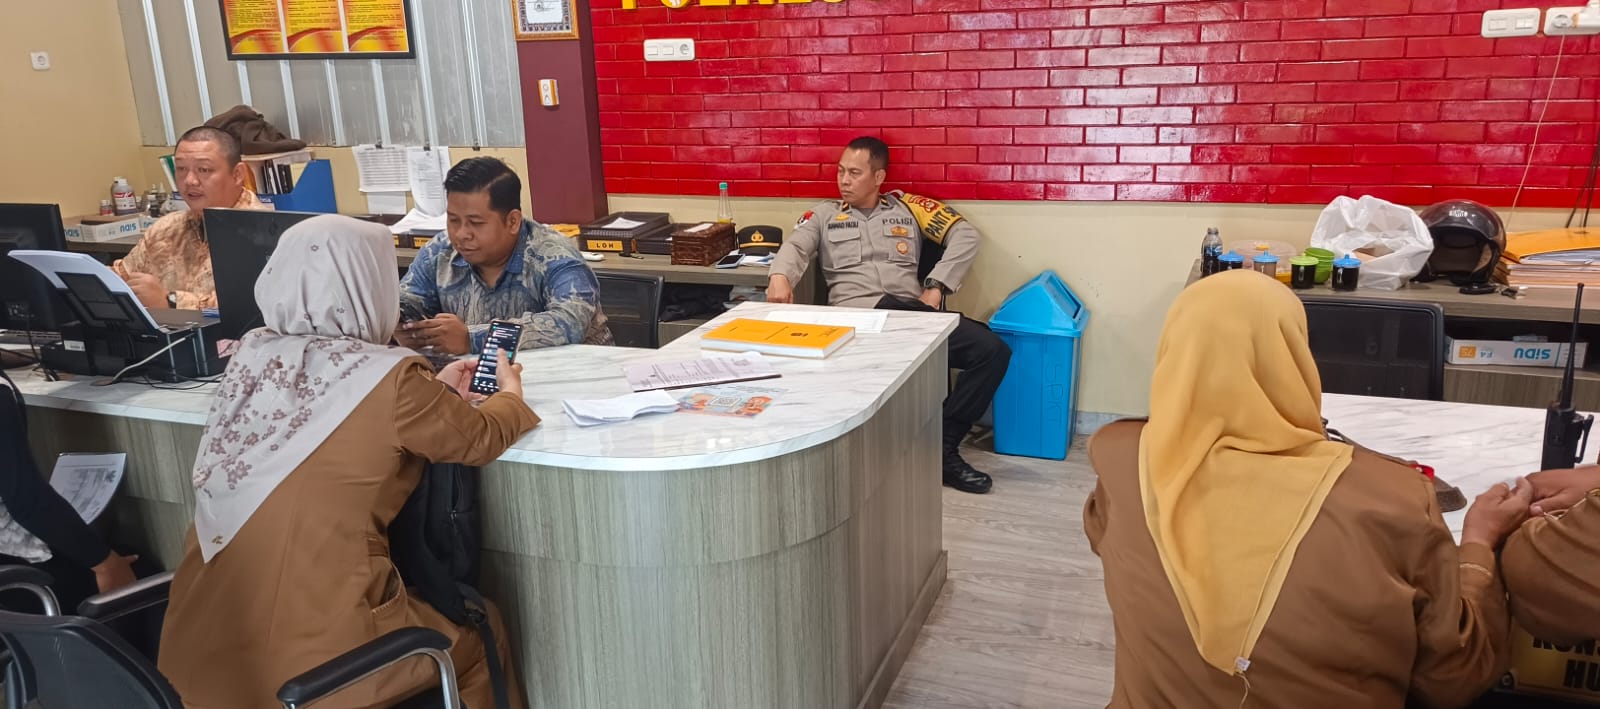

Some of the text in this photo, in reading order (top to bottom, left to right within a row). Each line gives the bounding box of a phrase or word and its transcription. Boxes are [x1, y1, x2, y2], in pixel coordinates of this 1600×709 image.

[882, 217, 913, 225] POLISI
[925, 211, 951, 239] PANIT
[1046, 362, 1064, 425] SPKT
